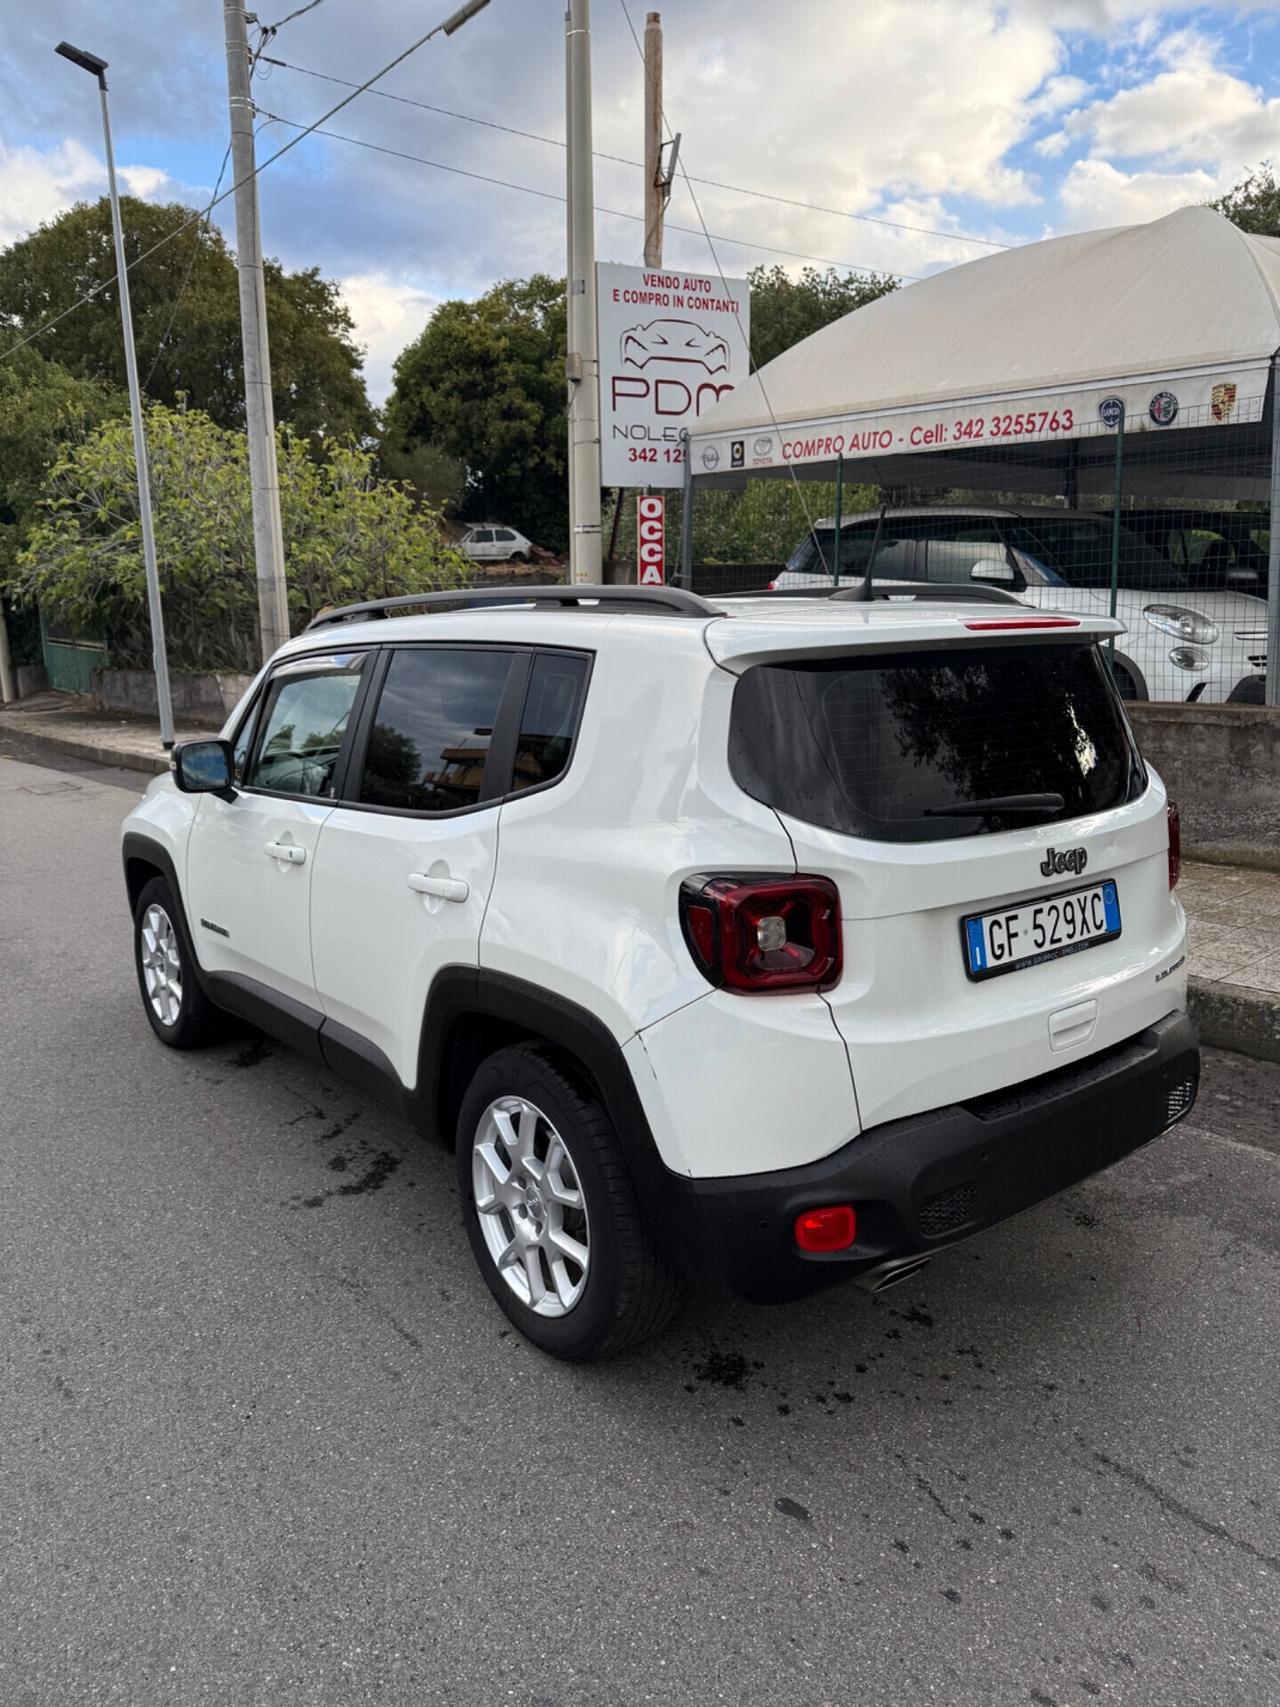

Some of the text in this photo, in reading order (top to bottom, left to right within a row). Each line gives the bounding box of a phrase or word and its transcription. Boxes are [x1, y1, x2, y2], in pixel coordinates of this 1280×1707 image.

[642, 273, 711, 293] VENDO AUTO
[613, 289, 739, 313] E COMPRO IN CONTANTI
[782, 435, 845, 460] COMPRO
[848, 430, 893, 451] AUTO
[910, 424, 948, 446] Cell:
[953, 418, 985, 441] 342
[990, 409, 1074, 437] 3255763
[628, 447, 657, 463] 342
[1040, 847, 1088, 877] Jeep
[988, 914, 1019, 961] GF
[1032, 893, 1104, 949] 529XC
